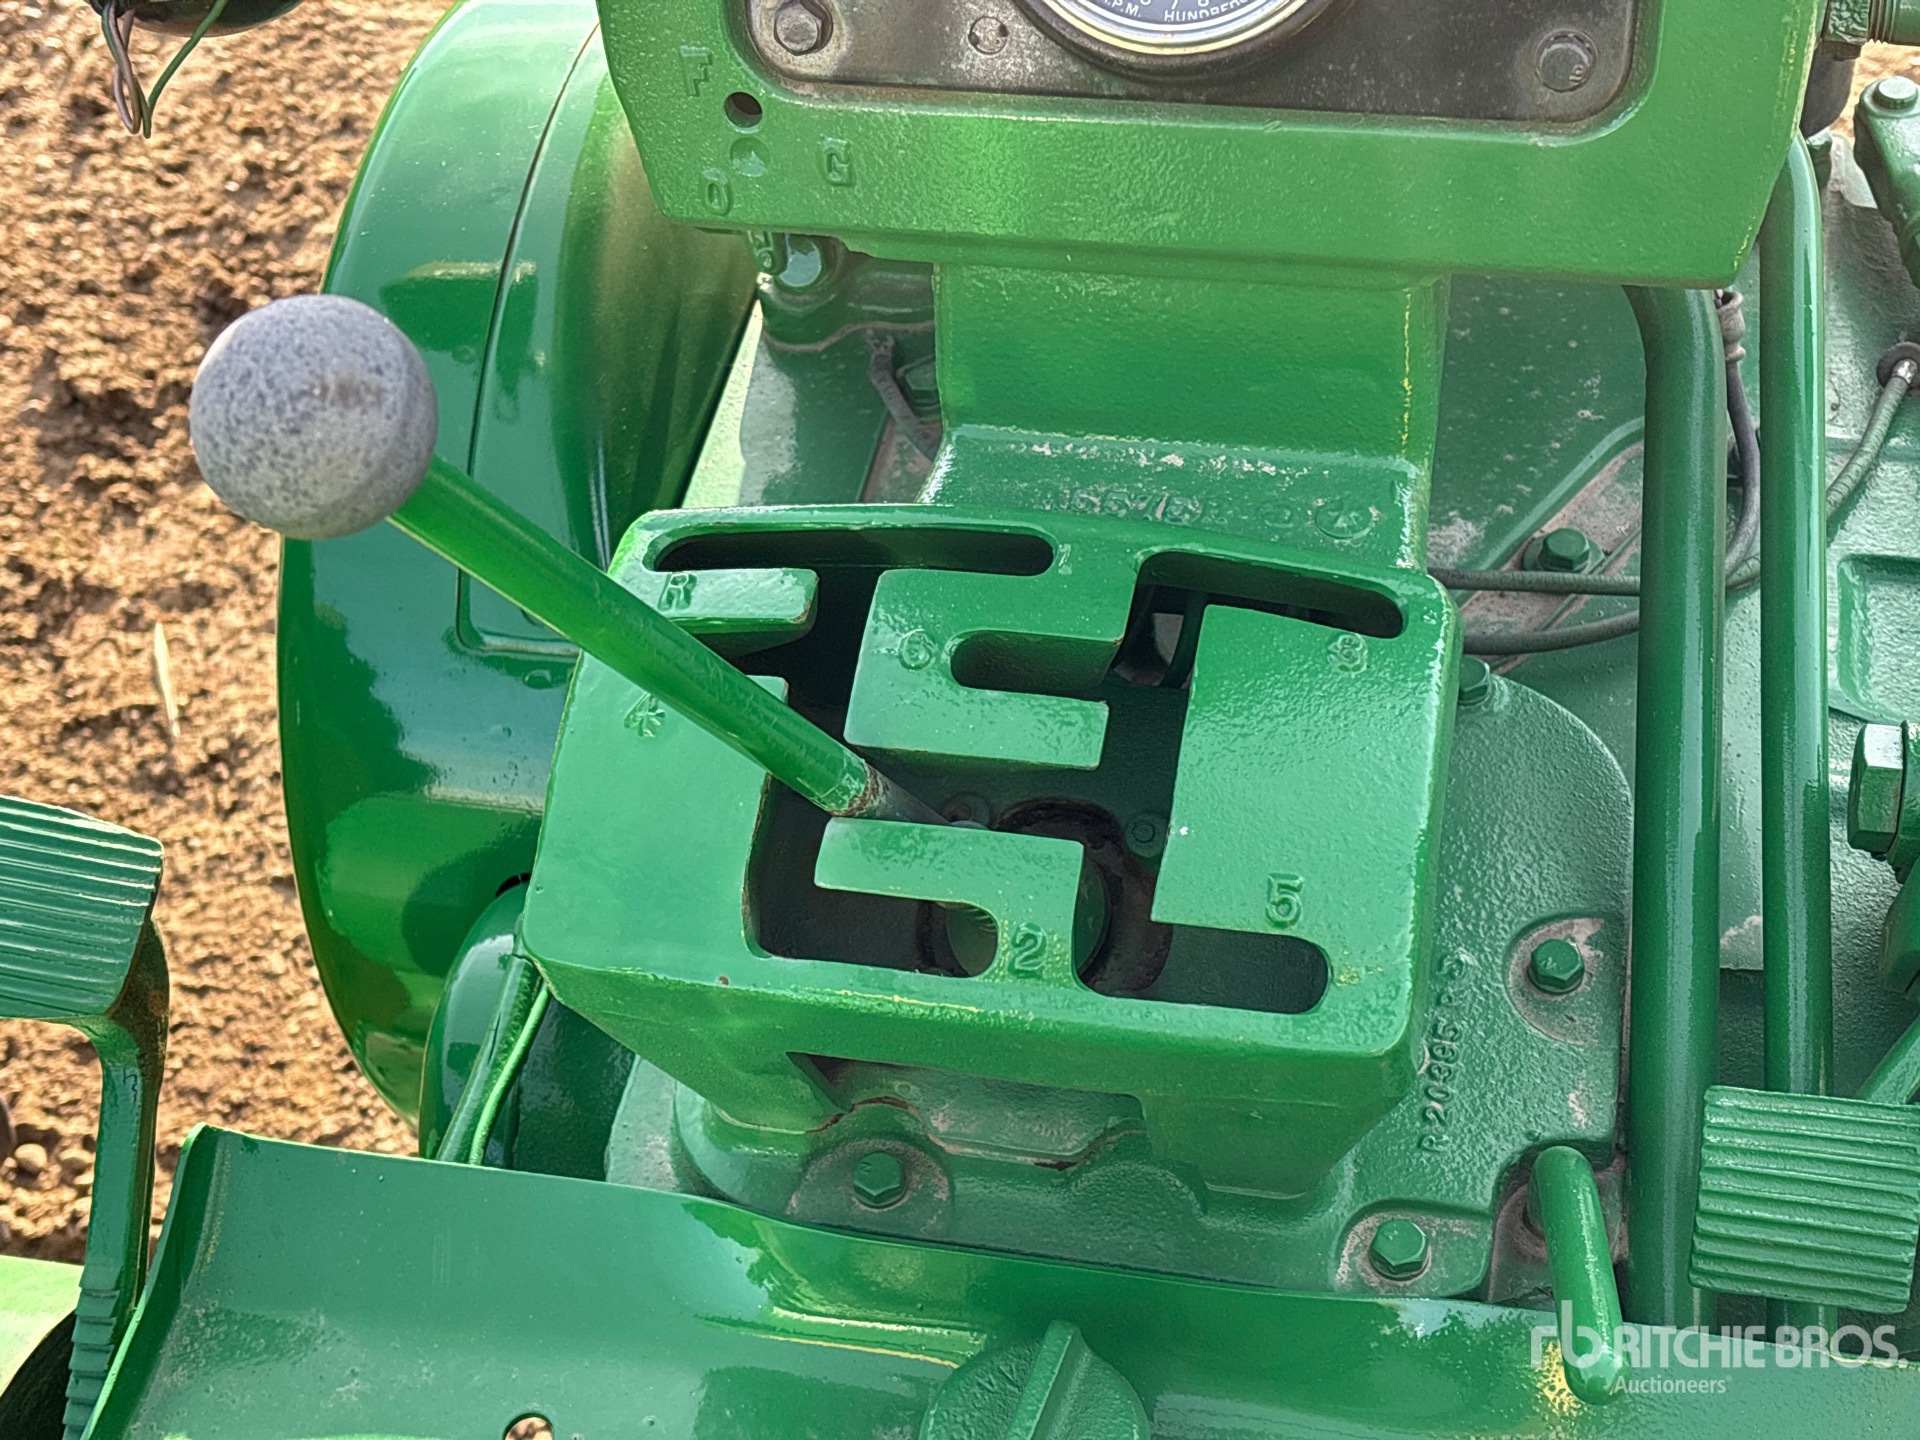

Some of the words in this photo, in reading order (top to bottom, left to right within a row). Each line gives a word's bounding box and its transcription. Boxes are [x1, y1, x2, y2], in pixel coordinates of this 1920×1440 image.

[657, 572, 698, 611] R
[1265, 872, 1303, 928] 5
[1007, 921, 1047, 979] 2
